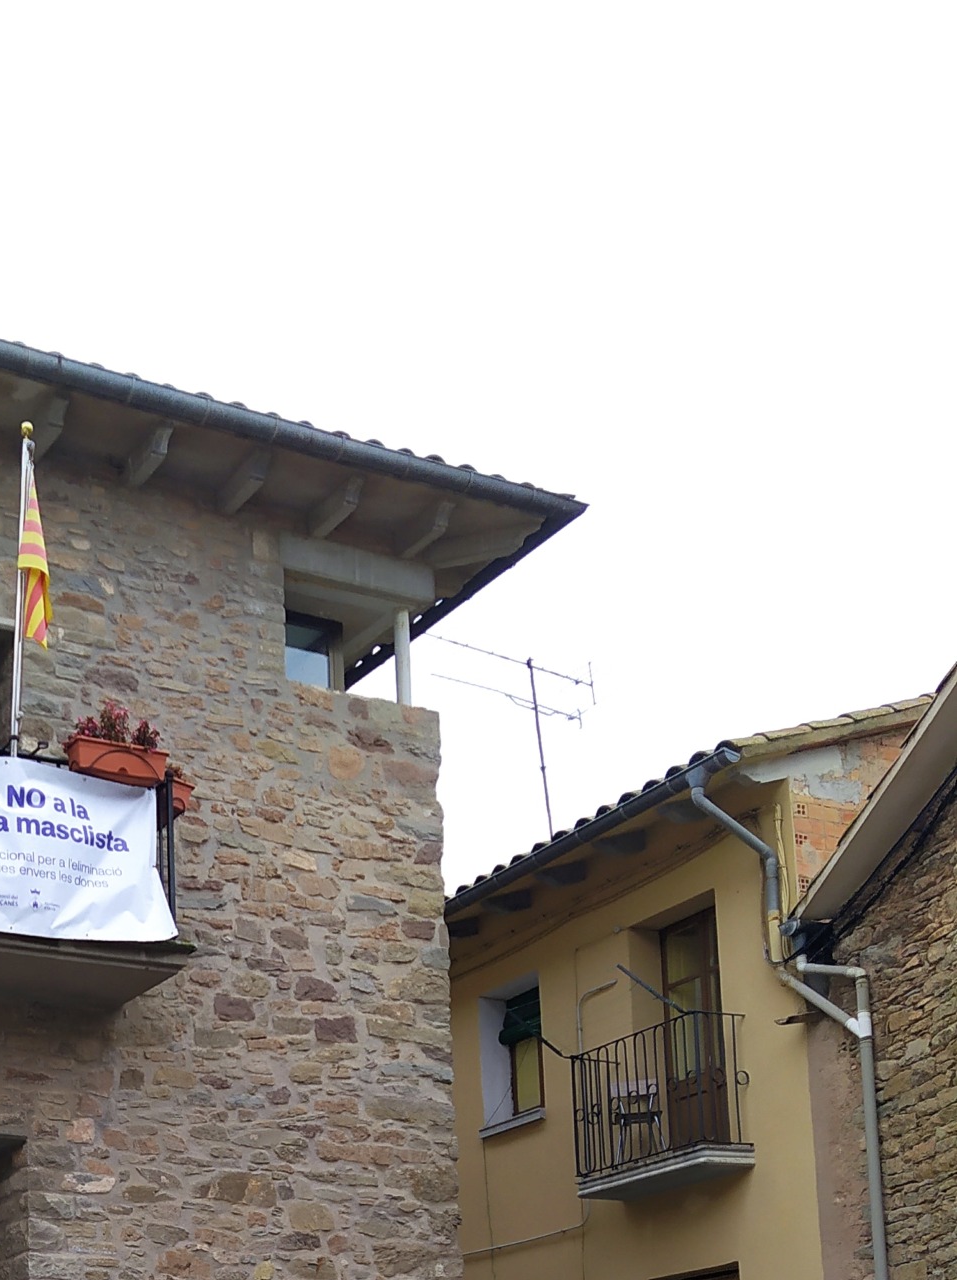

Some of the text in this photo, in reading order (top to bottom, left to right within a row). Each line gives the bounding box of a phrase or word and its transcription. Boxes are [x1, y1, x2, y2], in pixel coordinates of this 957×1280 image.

[7, 785, 46, 808] NO
[53, 797, 67, 814] a
[69, 797, 90, 821] la
[17, 816, 130, 852] masclista
[19, 866, 56, 880] envers
[59, 870, 73, 884] les
[74, 875, 109, 888] dones
[37, 855, 56, 866] per
[59, 858, 66, 868] a
[68, 858, 123, 876] l'eliminació
